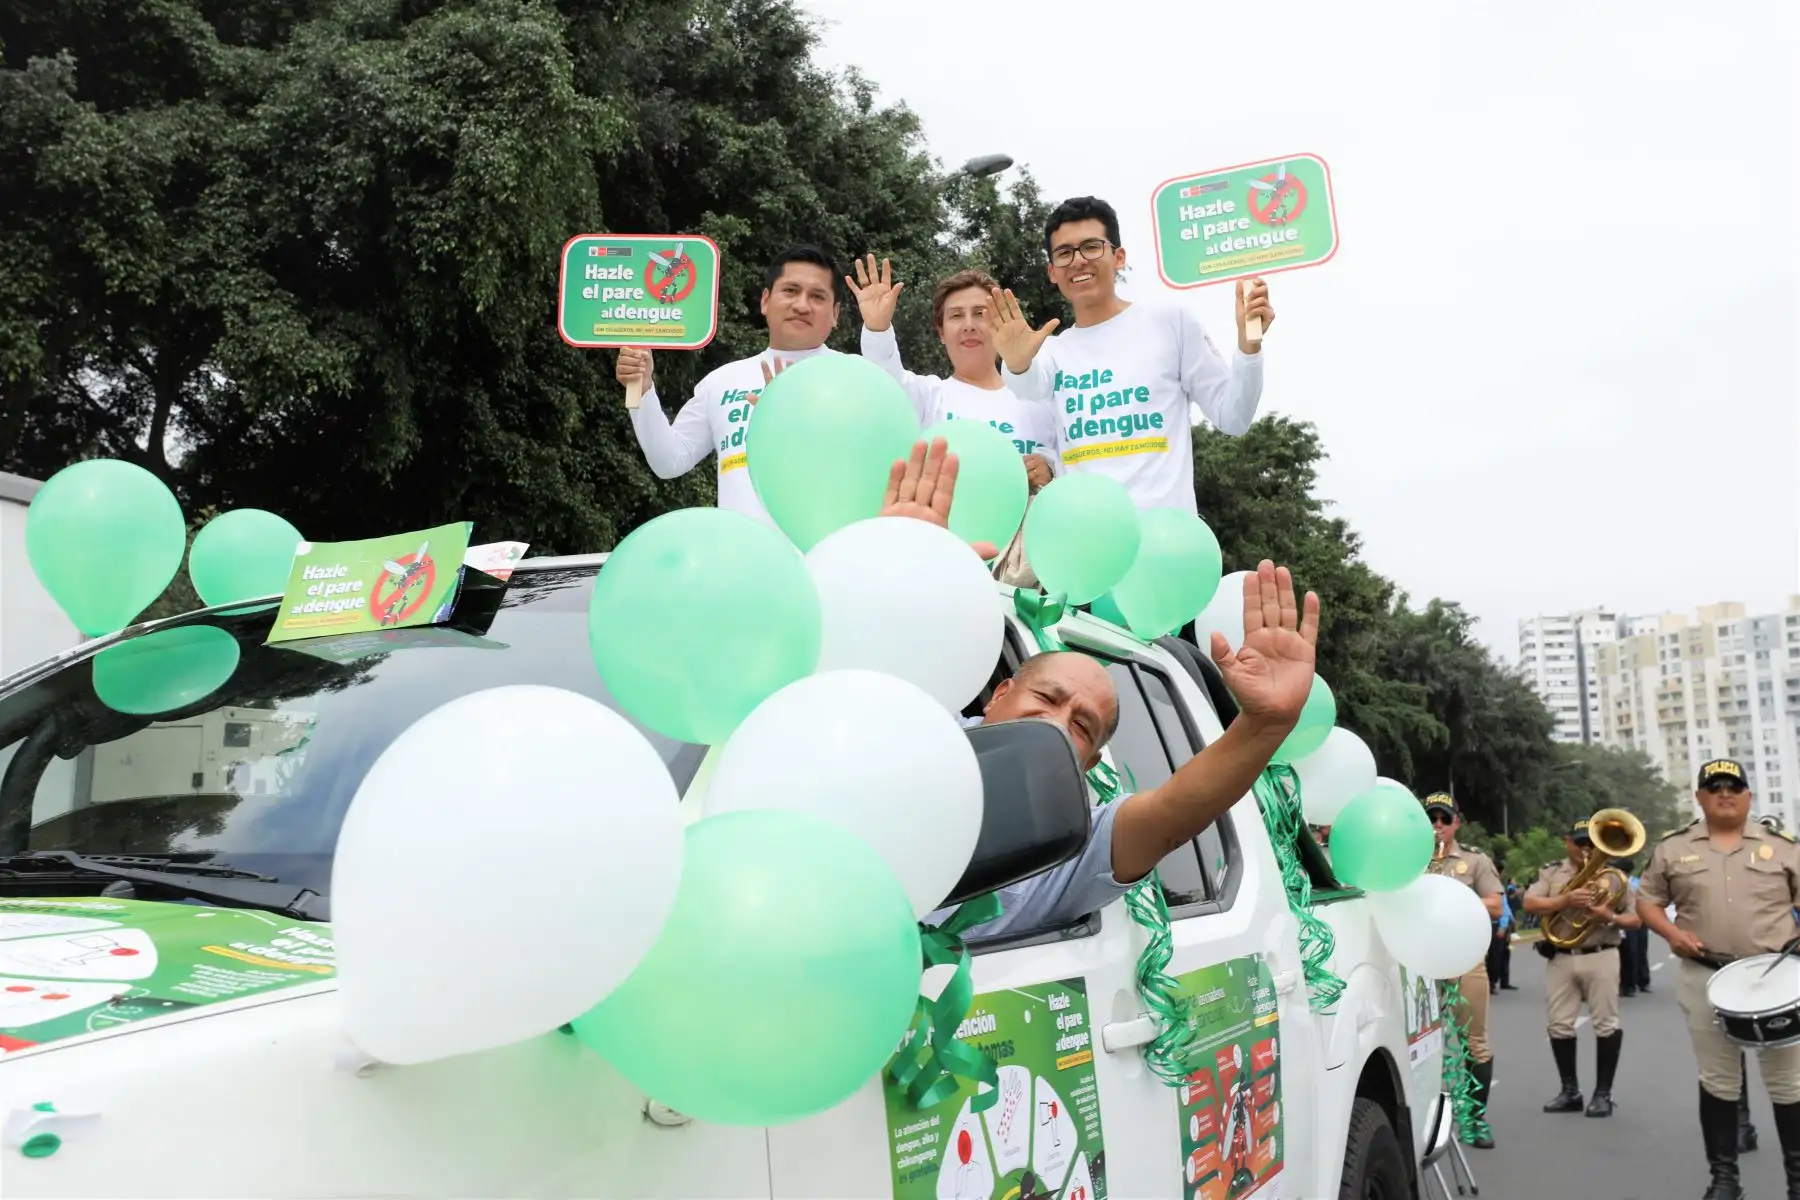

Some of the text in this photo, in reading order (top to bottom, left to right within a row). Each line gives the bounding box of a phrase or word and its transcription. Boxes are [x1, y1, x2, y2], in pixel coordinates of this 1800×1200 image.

[1179, 199, 1235, 222] Hazle
[1180, 216, 1251, 240] el pare
[1206, 228, 1298, 256] al dengue
[585, 264, 634, 280] Hazle
[582, 285, 644, 302] el pare
[601, 304, 683, 324] al dengue
[1066, 386, 1149, 415] el pare
[728, 404, 750, 422] el
[1069, 412, 1163, 440] dengue
[721, 435, 728, 451] al
[303, 563, 348, 580] Hazle
[307, 580, 363, 597] el pare
[291, 597, 365, 614] al dengue
[1048, 992, 1070, 1011] Hazle
[1056, 1012, 1083, 1032] el pare
[1061, 1032, 1089, 1051] dengue
